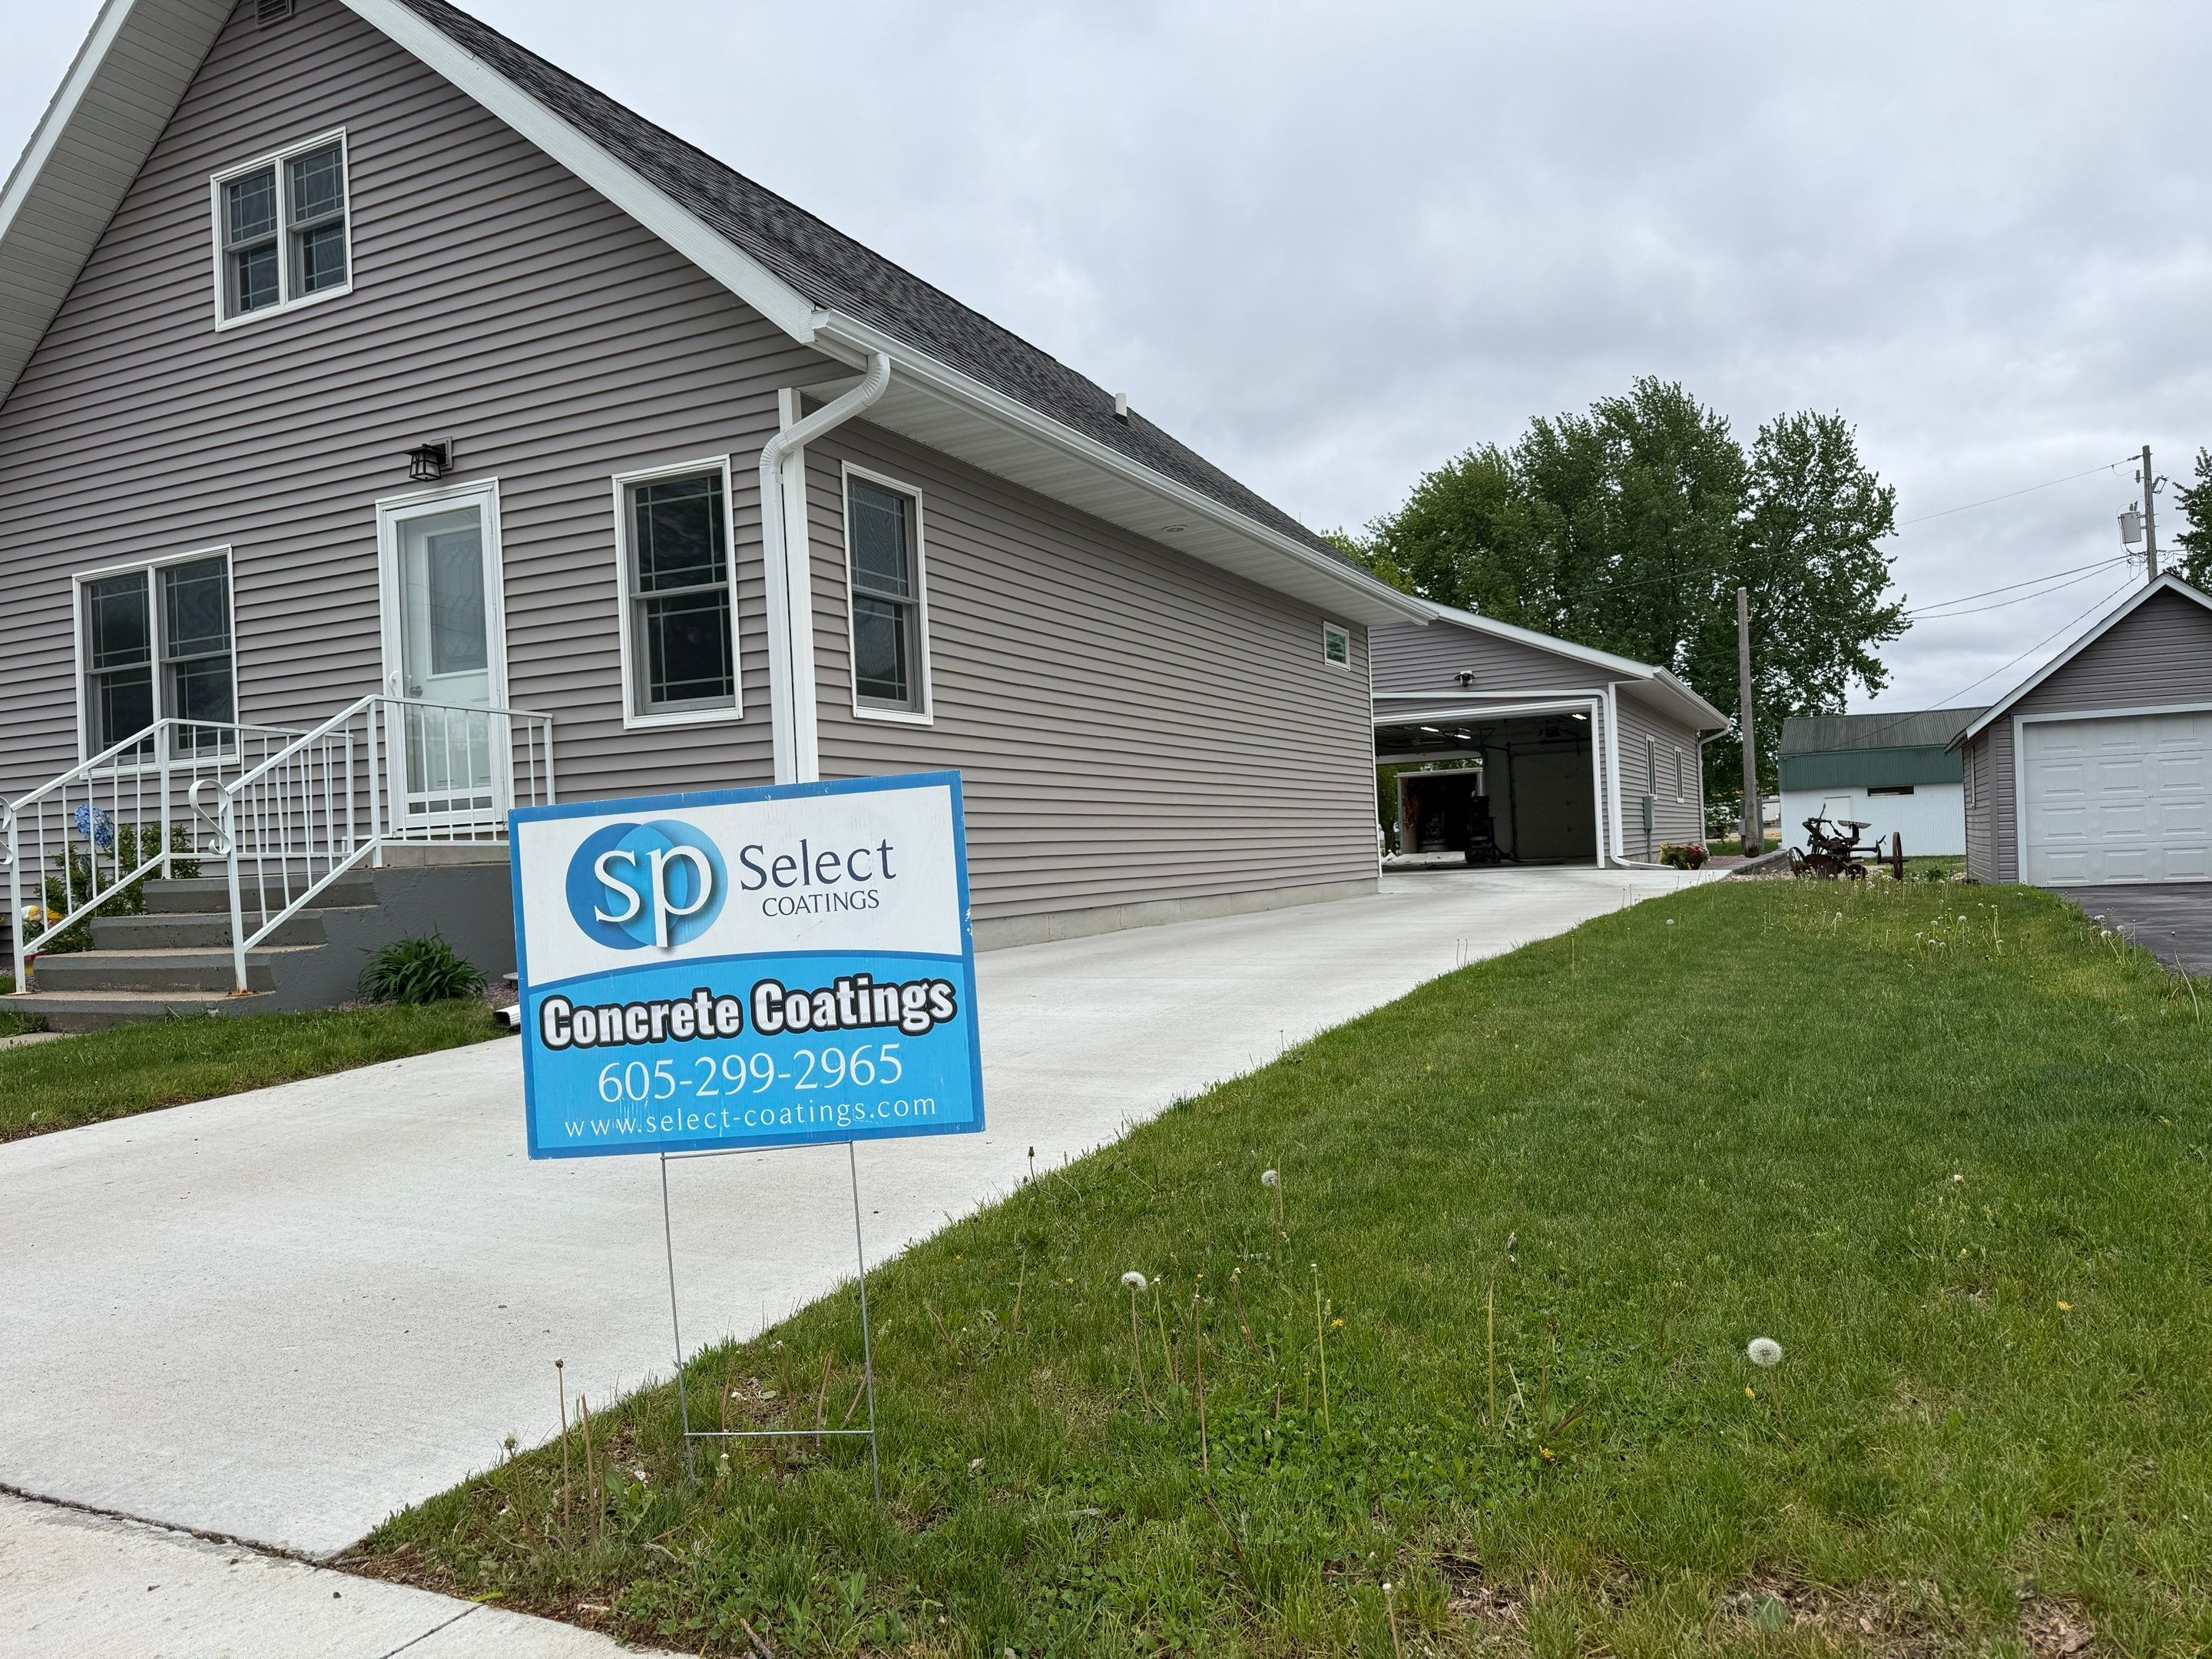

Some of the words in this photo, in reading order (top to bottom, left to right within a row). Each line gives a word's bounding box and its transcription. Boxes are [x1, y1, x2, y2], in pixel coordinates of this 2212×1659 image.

[740, 838, 897, 892] Select
[593, 844, 713, 949] sp
[762, 889, 880, 917] COATINGS
[541, 989, 742, 1049] Concrete
[752, 974, 955, 1035] Coatings
[598, 1043, 903, 1104] 605-299-2965
[565, 1096, 936, 1137] www.select-coatings.com
